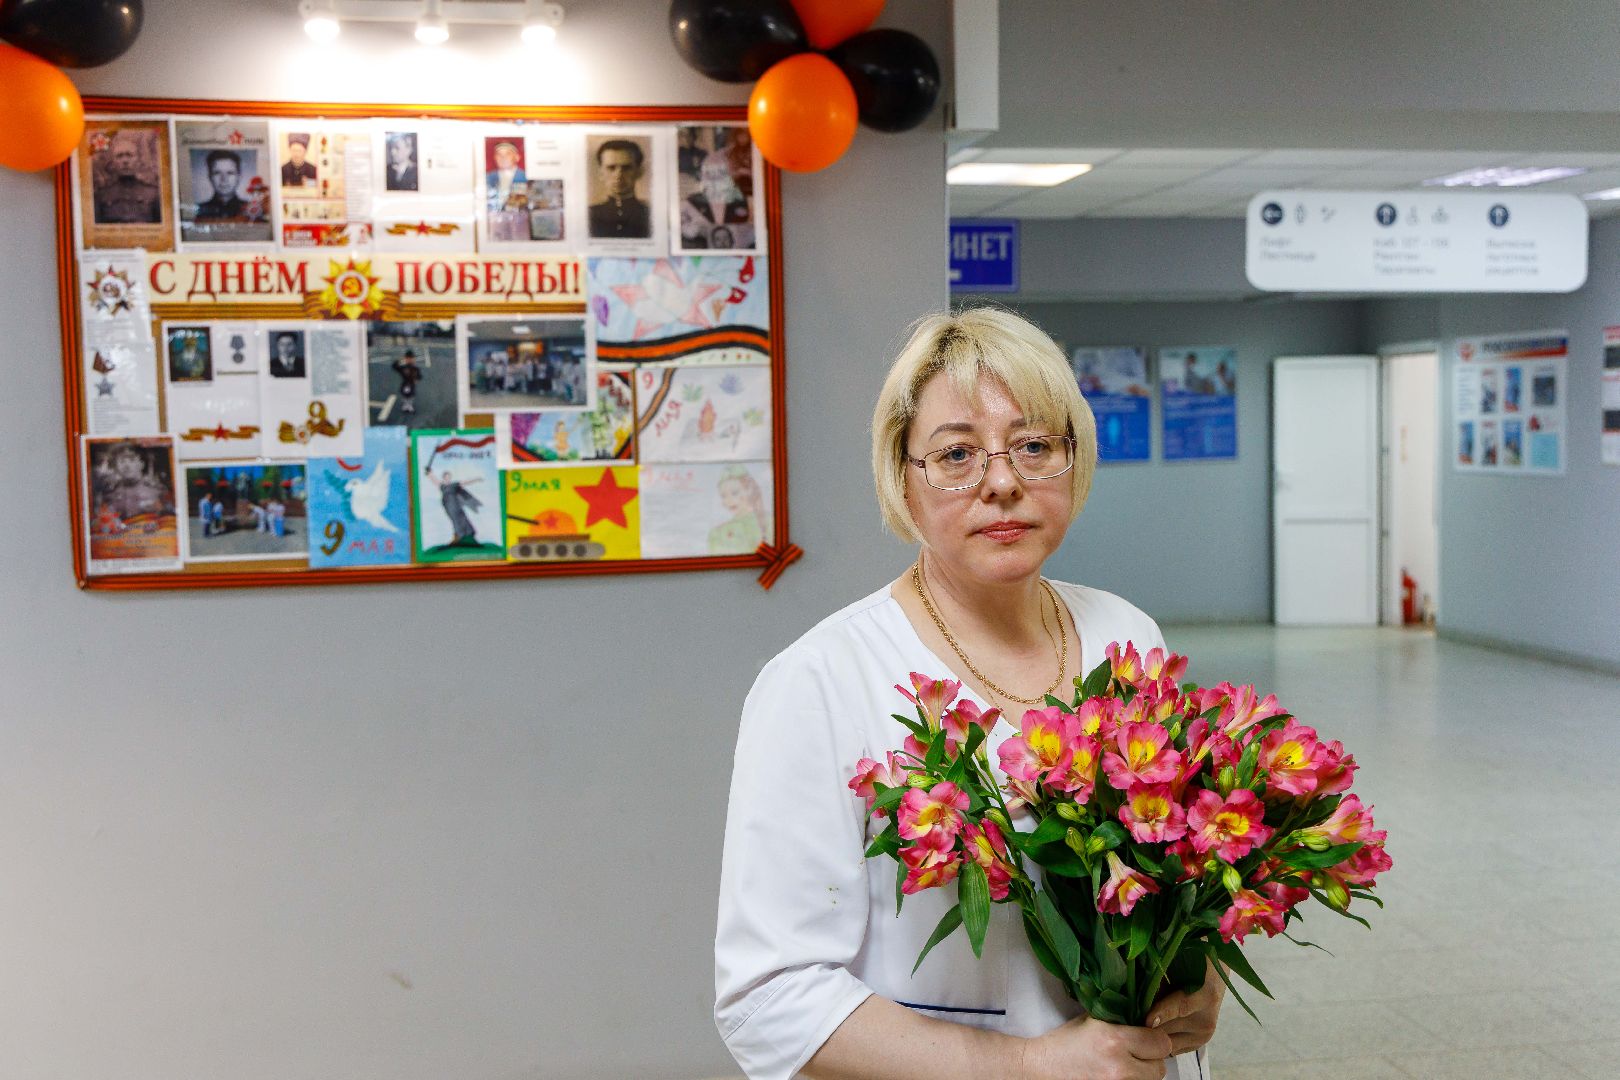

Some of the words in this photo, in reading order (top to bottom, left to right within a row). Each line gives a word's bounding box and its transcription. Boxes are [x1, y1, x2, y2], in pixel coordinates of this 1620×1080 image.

[149, 261, 176, 295] С
[187, 256, 309, 300] ДНЁМ
[395, 261, 580, 300] ПОБЕДЫ!
[642, 371, 654, 390] 9
[510, 472, 522, 492] 9
[320, 519, 346, 557] 9
